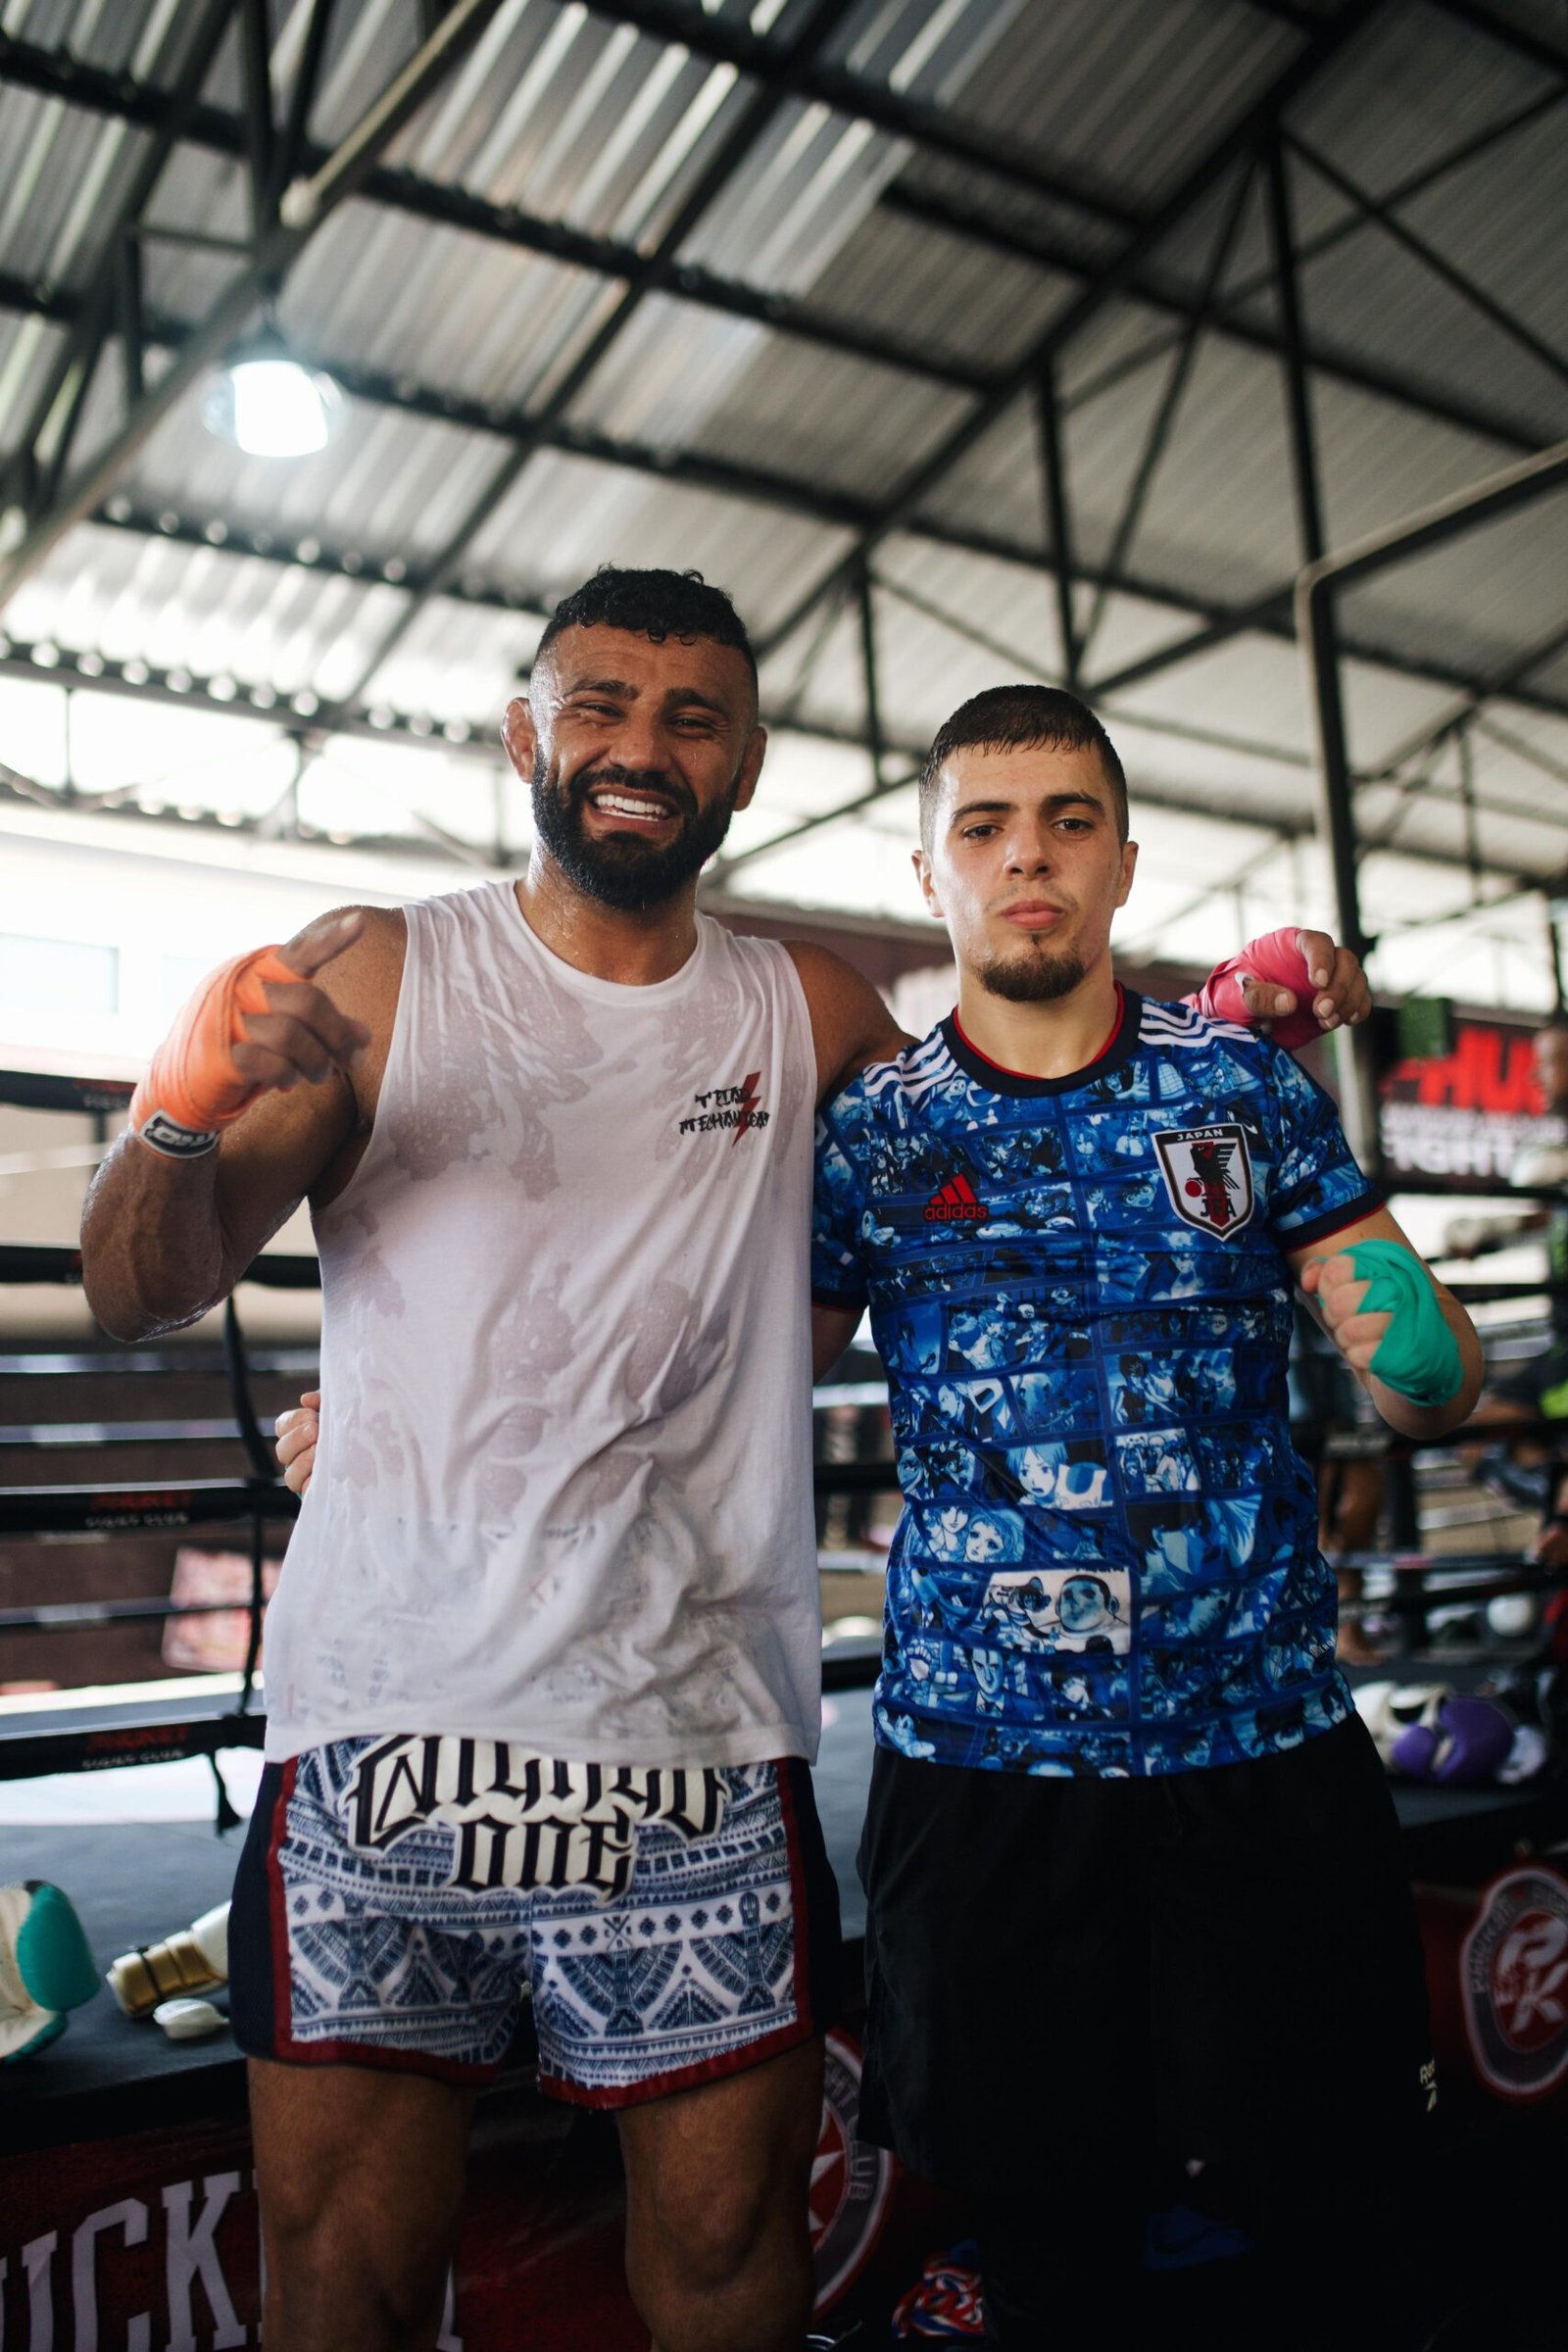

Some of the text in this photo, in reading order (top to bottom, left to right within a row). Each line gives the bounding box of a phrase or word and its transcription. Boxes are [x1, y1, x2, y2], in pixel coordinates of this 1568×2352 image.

[1176, 1128, 1224, 1142] JAPAN
[924, 1204, 989, 1221] adidas
[1200, 1198, 1237, 1218] JFA
